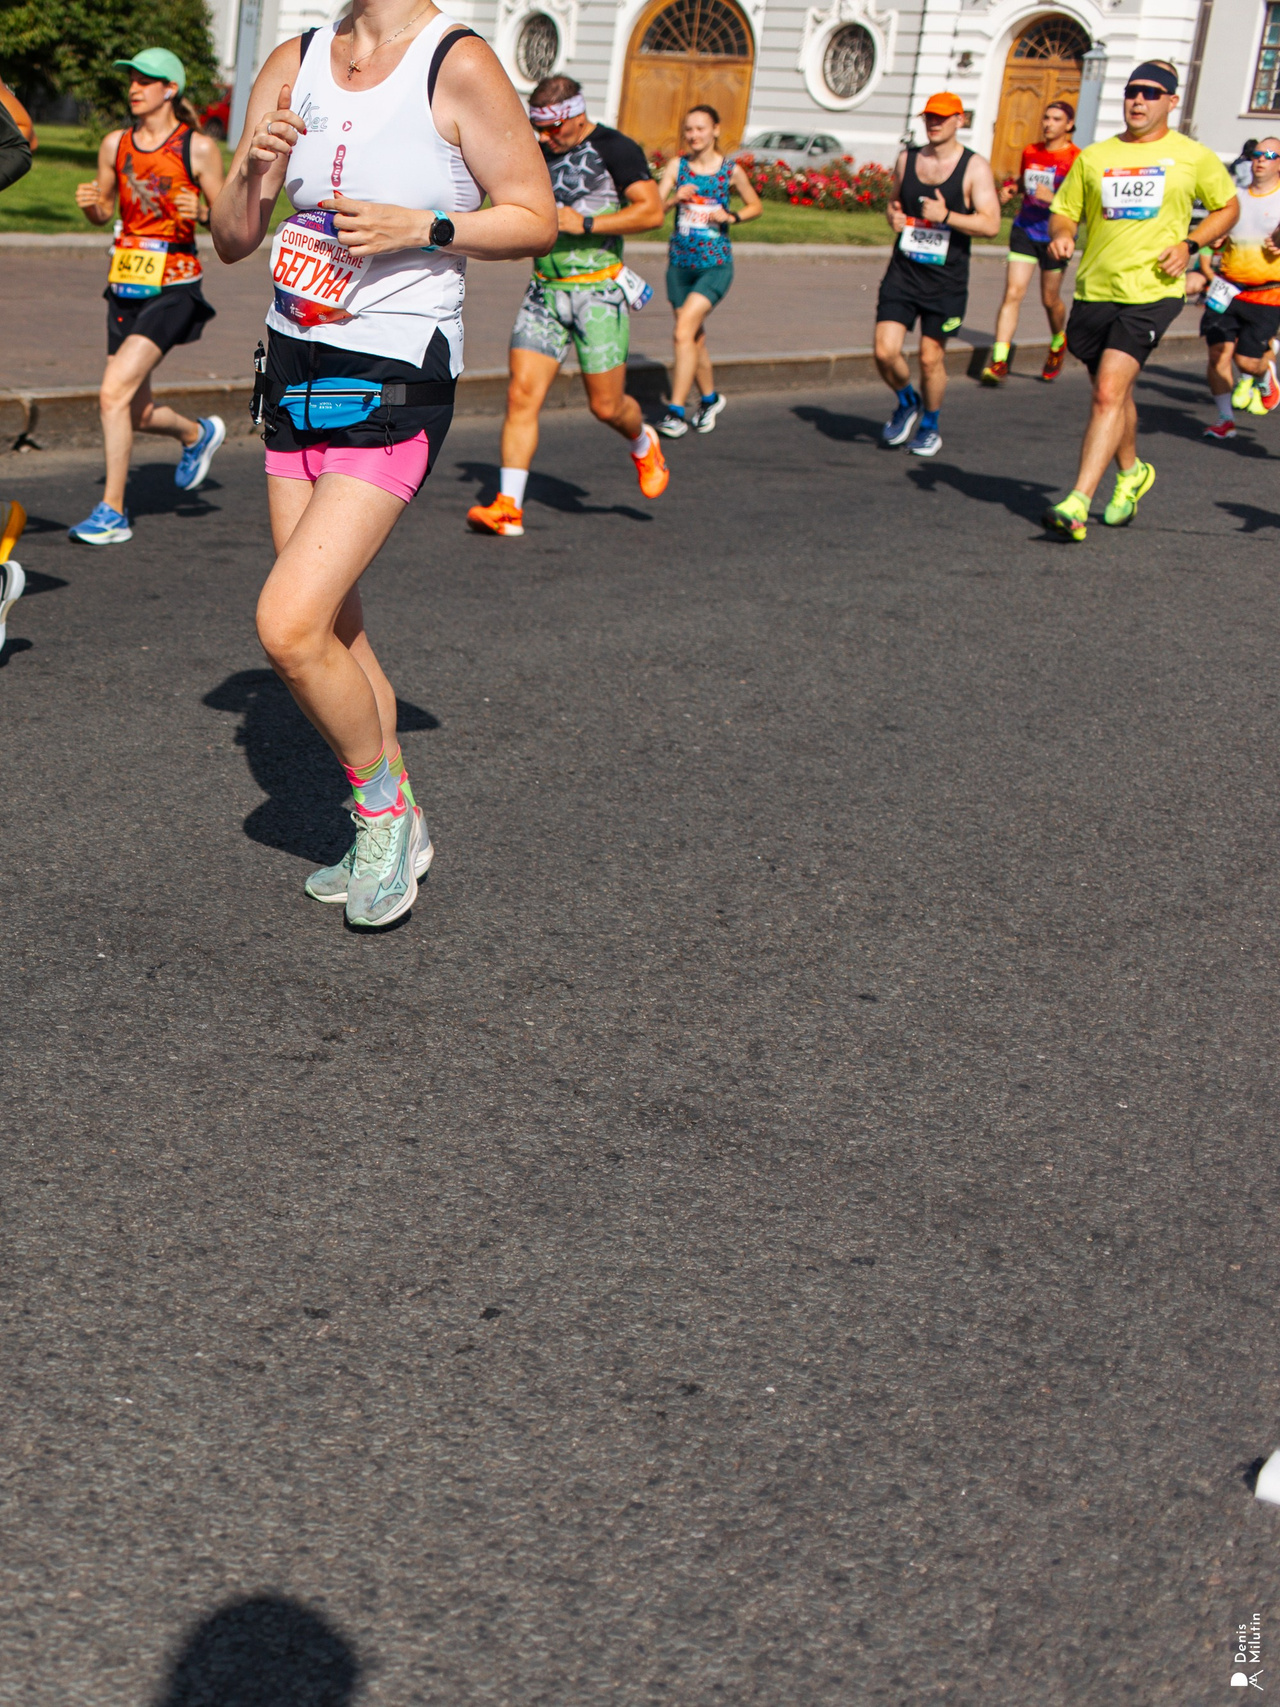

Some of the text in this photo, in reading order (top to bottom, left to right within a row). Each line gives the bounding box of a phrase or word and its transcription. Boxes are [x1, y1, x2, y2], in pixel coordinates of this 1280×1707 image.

[1112, 181, 1155, 197] 1482
[281, 229, 365, 269] СОПРОВОЖДЕНИЕ
[273, 246, 354, 303] БЕГУНА
